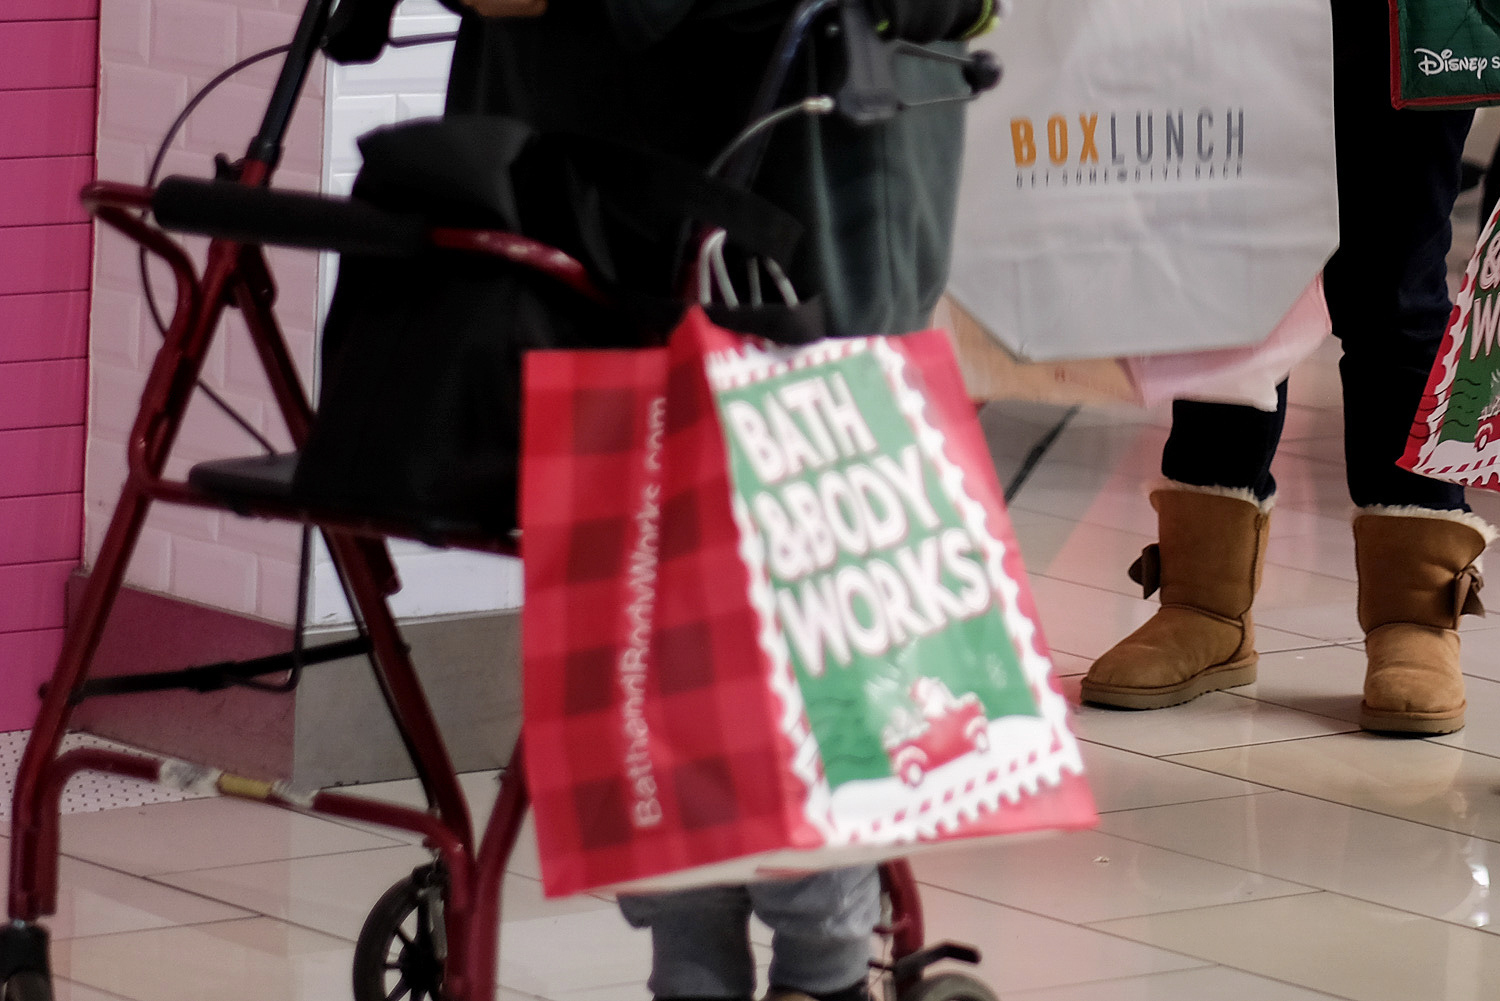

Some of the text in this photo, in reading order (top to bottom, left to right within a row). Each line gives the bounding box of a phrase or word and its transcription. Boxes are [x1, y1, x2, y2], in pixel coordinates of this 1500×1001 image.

[727, 373, 878, 485] BATH
[753, 447, 943, 582] &BODY
[621, 398, 667, 827] BathandBodyWorkscom
[776, 526, 993, 679] WORKS
